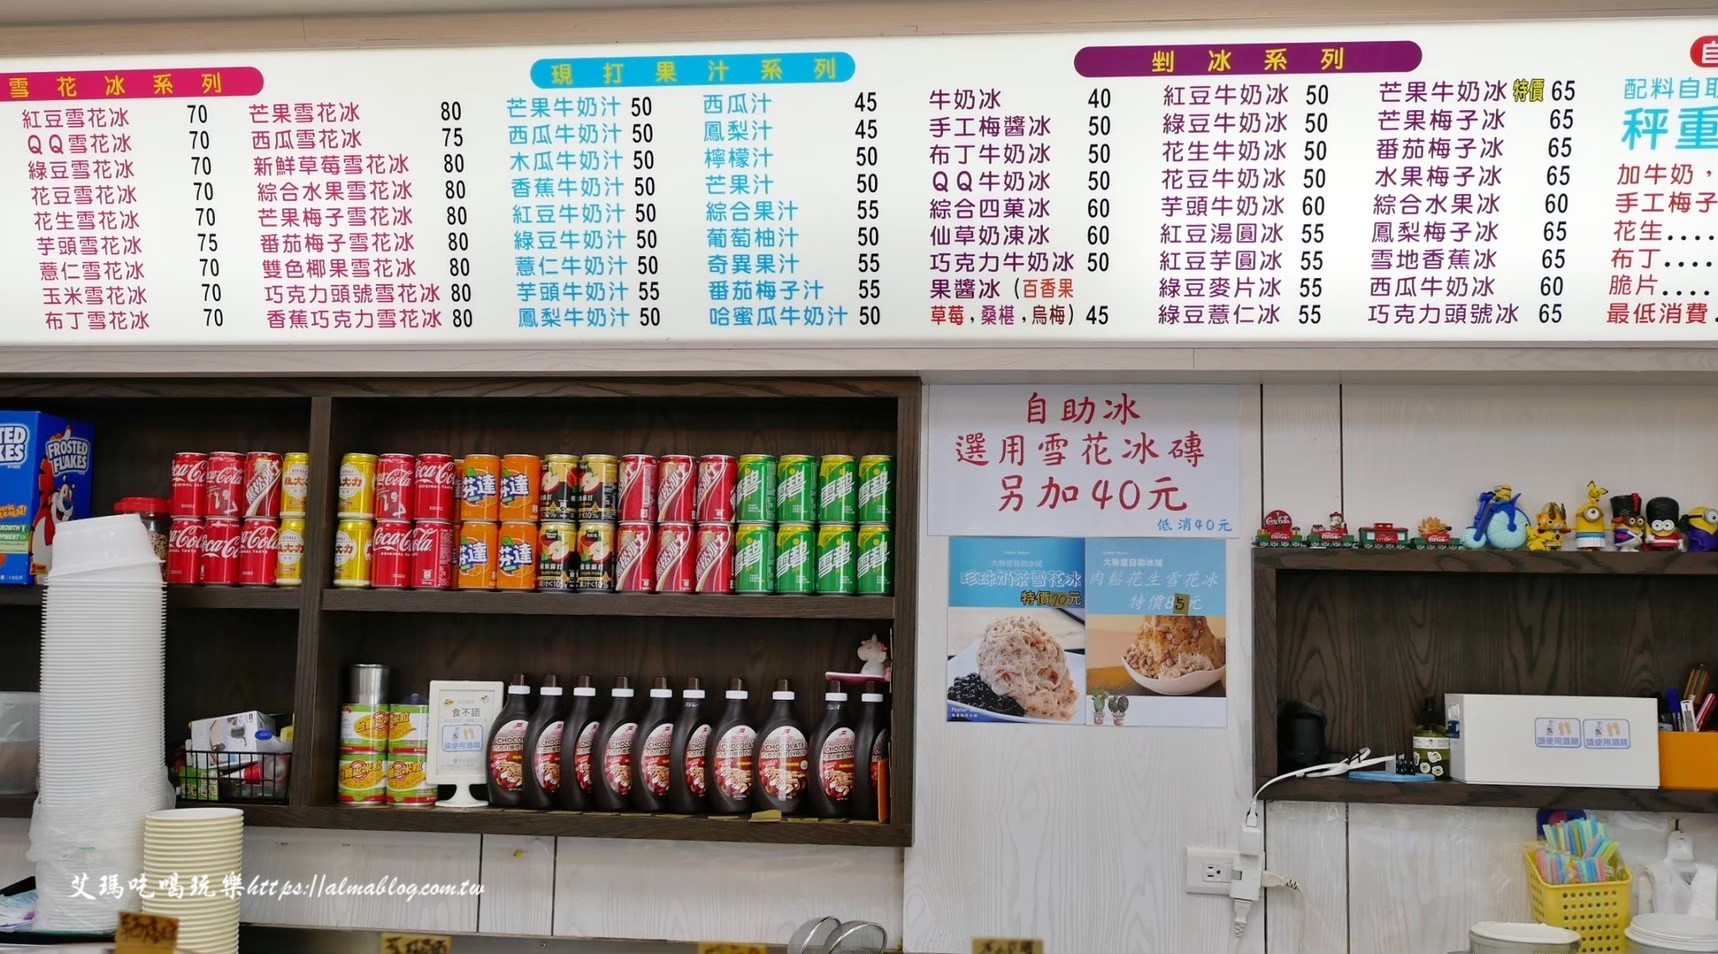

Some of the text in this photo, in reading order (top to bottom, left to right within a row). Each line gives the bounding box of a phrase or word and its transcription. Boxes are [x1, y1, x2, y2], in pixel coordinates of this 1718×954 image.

[551, 58, 837, 85] 現打果汁系列
[9, 73, 223, 98] 雪花冰系列
[1163, 83, 1328, 106] 紅豆牛奶冰 50
[1379, 78, 1575, 103] 芒果牛奶冰 特價 65
[507, 96, 652, 118] 芒果牛奶汁 50
[703, 92, 877, 114] 西瓜汁 45
[929, 88, 1111, 110] 牛奶冰 40
[22, 104, 207, 129] 紅豆雪花冰 70
[249, 101, 461, 123] 芒果雪花冰 80
[1163, 111, 1327, 134] 綠豆牛奶冰 50
[1378, 108, 1573, 131] 芒果梅子冰 65
[508, 123, 653, 144] 西瓜牛奶汁 50
[704, 119, 877, 141] 鳳梨汁 45
[929, 115, 1110, 138] 手工梅醬冰 50
[1621, 106, 1718, 150] 秤重
[28, 131, 209, 155] QQ雪花冰 70
[251, 127, 463, 150] 西瓜雪花冰 75
[1376, 137, 1572, 159] 番茄梅子冰 65
[510, 150, 654, 171] 木瓜牛奶汁 50
[705, 146, 878, 168] 檸檬汁 50
[929, 143, 1110, 165] 布丁牛奶冰 50
[1162, 139, 1327, 162] 花生牛奶冰 50
[28, 156, 211, 180] 綠豆雪花冰 70
[253, 154, 464, 176] 新鮮草莓雪花冰 80
[1375, 165, 1570, 187] 水果梅子冰 65
[512, 176, 655, 197] 香蕉牛奶汁 50
[705, 173, 878, 194] 芒果汁 50
[933, 170, 1110, 192] QQ牛奶冰 50
[1162, 167, 1325, 190] 花豆牛奶冰 50
[31, 182, 213, 206] 花豆雪花冰 70
[257, 180, 465, 202] 綜合水果雪花冰 80
[513, 203, 656, 224] 紅豆牛奶汁 50
[706, 200, 879, 222] 綜合果汁 55
[930, 197, 1110, 219] 綜合四菓冰 60
[1161, 195, 1325, 217] 芋頭牛奶冰 60
[1373, 193, 1568, 215] 綜合水果冰 60
[33, 208, 215, 231] 花生雪花冰 70
[258, 206, 467, 227] 芒果梅子雪花冰 80
[260, 232, 468, 253] 番茄梅子雪花冰 80
[514, 229, 657, 250] 綠豆牛奶汁 50
[707, 226, 879, 248] 葡萄柚汁 50
[930, 224, 1109, 246] 仙草奶凍冰 60
[1160, 223, 1324, 244] 紅豆湯圓冰 55
[1372, 221, 1566, 243] 鳳梨梅子冰 65
[36, 233, 218, 256] 芋頭雪花冰 75
[39, 258, 219, 281] 薏仁雪花冰 70
[262, 257, 470, 279] 雙色椰果雪花冰 80
[515, 255, 658, 276] 薏仁牛奶汁 50
[708, 253, 880, 274] 奇異果汁 55
[930, 251, 1109, 273] 巧克力牛奶冰 50
[1160, 250, 1323, 271] 紅豆芋圓冰 55
[1371, 248, 1565, 270] 雪地香蕉冰 65
[43, 283, 221, 305] 玉米雪花冰 70
[264, 283, 471, 304] 巧克力頭號雪花冰 80
[517, 281, 659, 302] 芋頭牛奶汁 55
[708, 279, 880, 300] 番茄梅子汁 55
[1159, 277, 1322, 298] 綠豆麥片冰 55
[1370, 276, 1563, 297] 西瓜牛奶冰 60
[45, 308, 223, 330] 布丁雪花冰 70
[267, 309, 473, 329] 香蕉巧克力雪花冰 80
[519, 307, 660, 327] 鳳梨牛奶汁 50
[710, 306, 880, 326] 哈蜜瓜牛奶汁 50
[1086, 305, 1108, 325] 45
[1158, 304, 1321, 325] 綠豆薏仁冰 55
[1368, 303, 1562, 324] 巧克力頭號冰 65
[1026, 392, 1140, 425] 自助冰
[48, 440, 88, 458] FROSTED
[955, 431, 1205, 468] 選用雪花冰磚
[53, 456, 87, 474] FLAKES
[463, 474, 496, 498] 芬達
[999, 475, 1187, 513] 另加40元
[1157, 518, 1233, 533] 低消40元
[500, 542, 532, 567] 芬達
[1089, 571, 1219, 588] 肉鬆花生雪花冰
